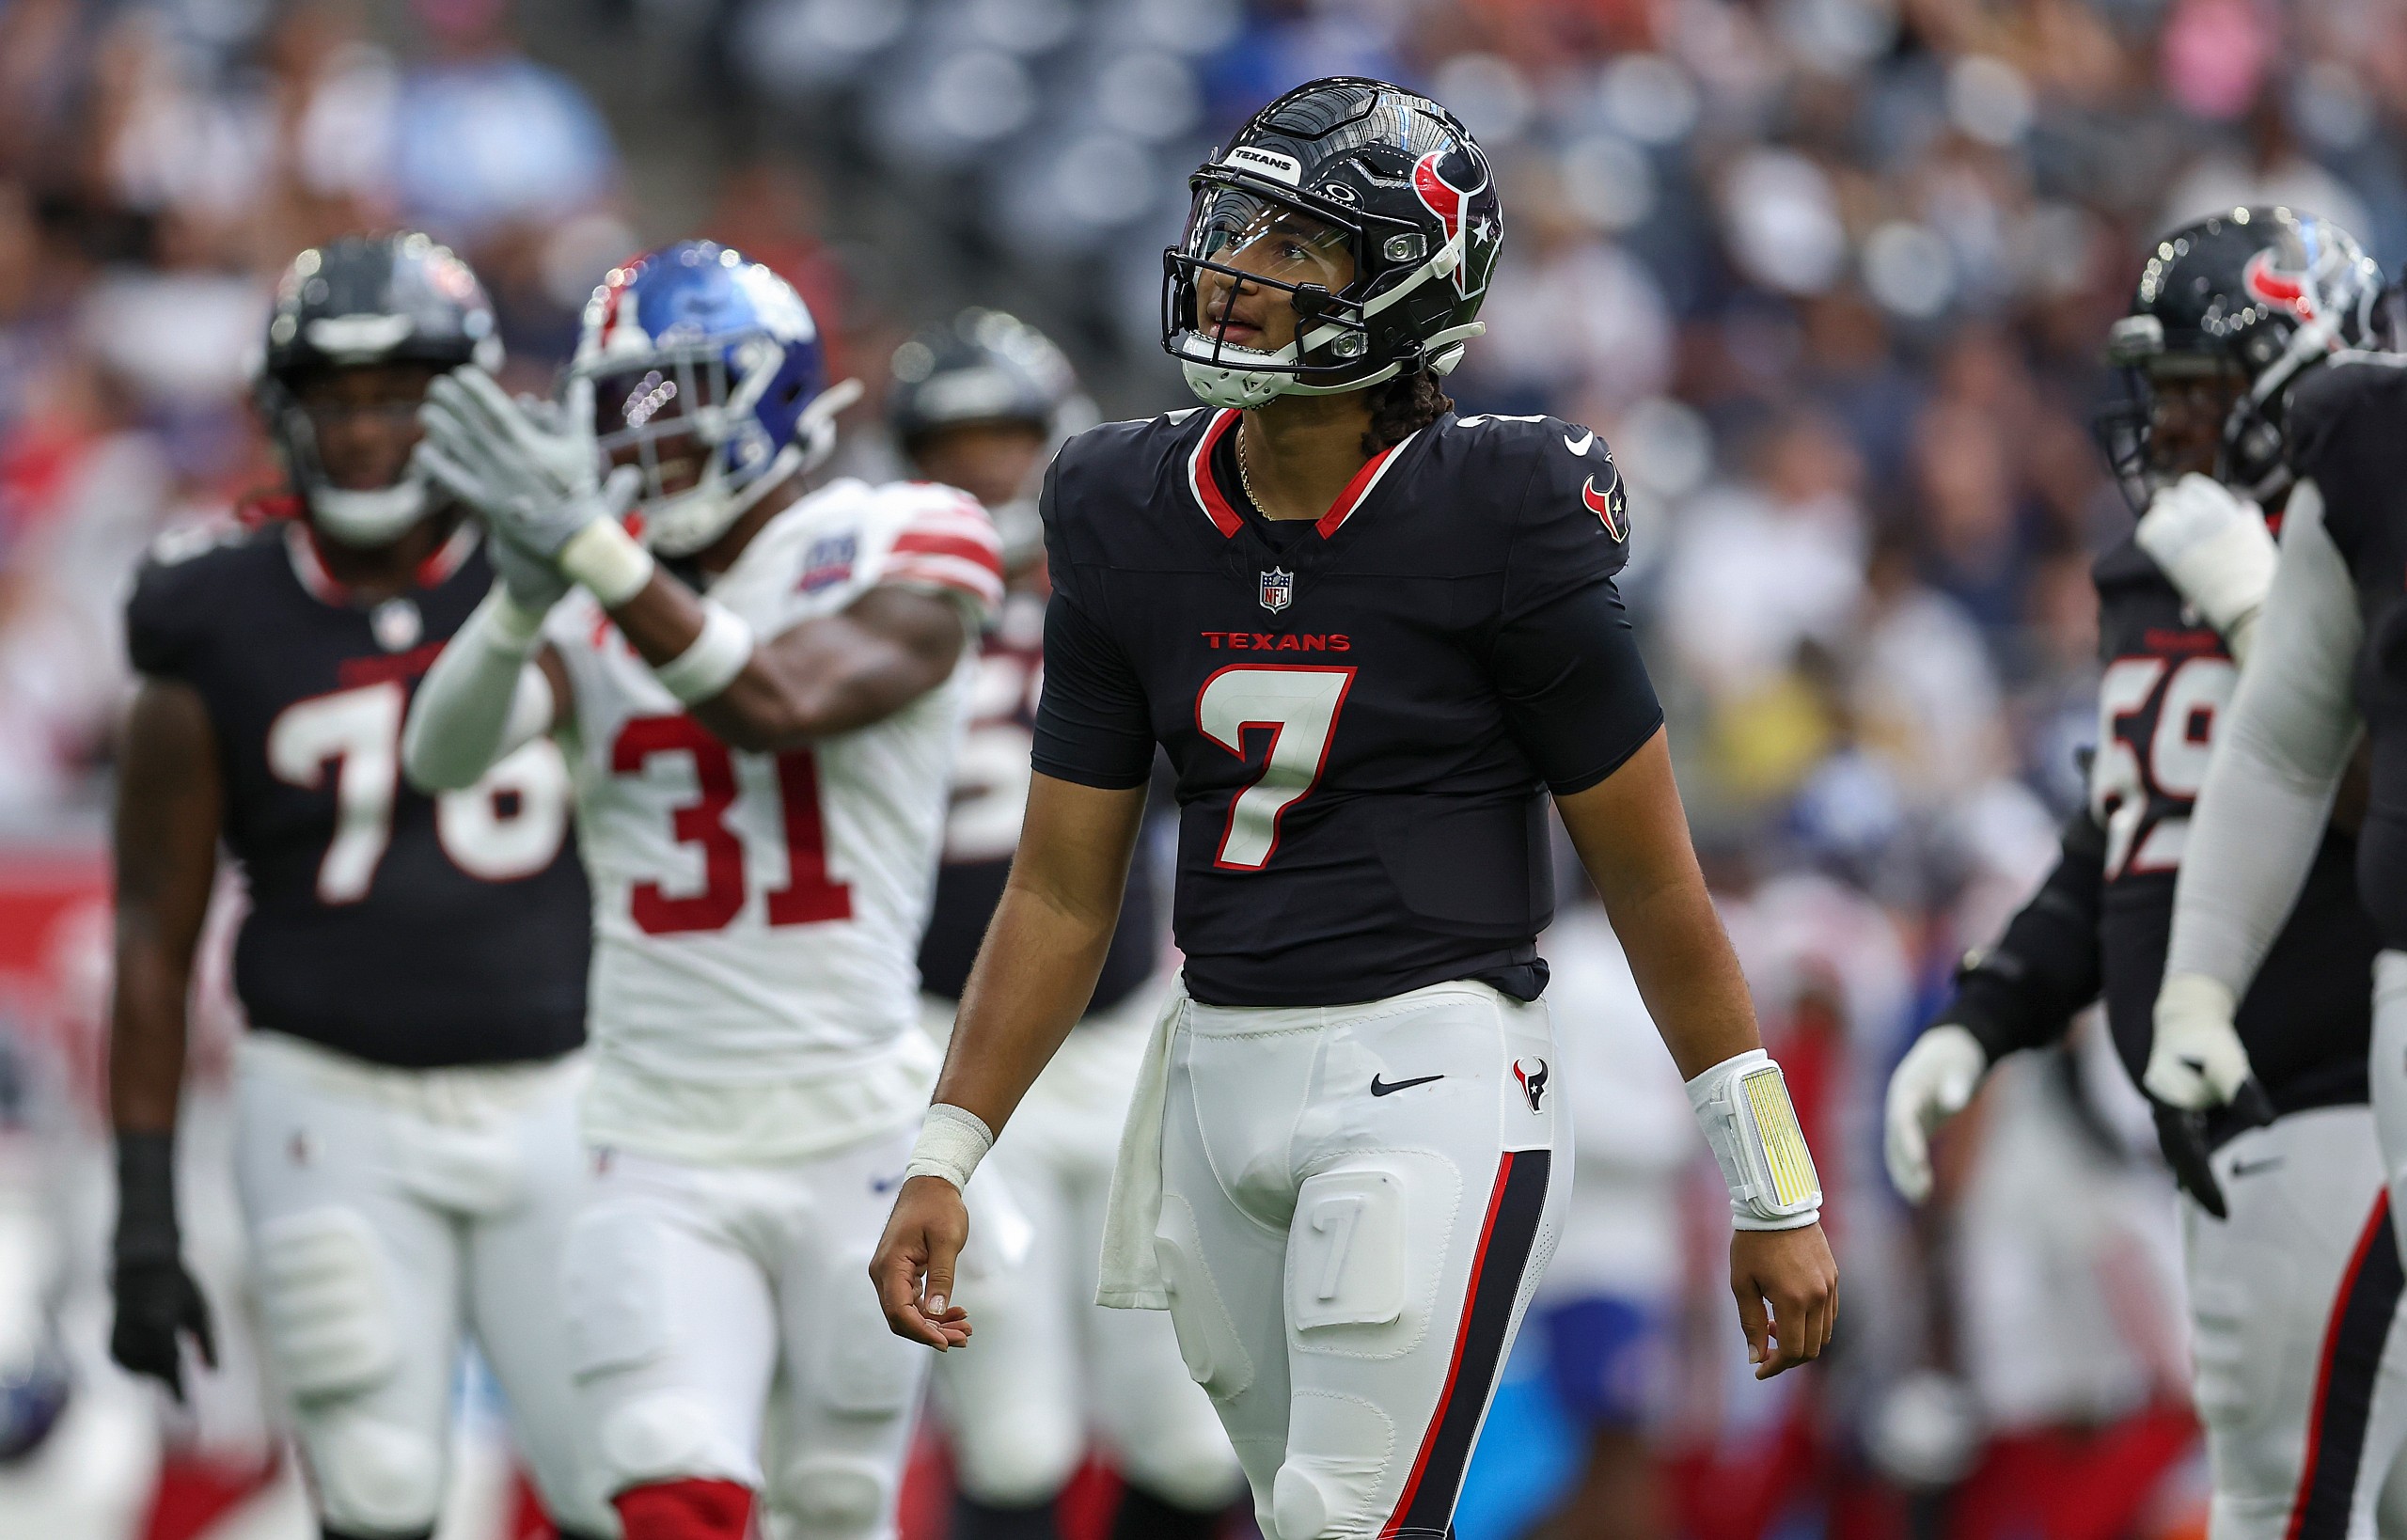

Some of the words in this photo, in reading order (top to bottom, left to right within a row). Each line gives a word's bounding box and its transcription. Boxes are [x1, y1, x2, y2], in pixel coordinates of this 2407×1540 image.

[1235, 149, 1292, 171] TEXANS
[1265, 588, 1287, 605] NFL
[1201, 631, 1351, 652] TEXANS
[1194, 663, 1359, 871] 7
[612, 713, 854, 936] 31
[1313, 1195, 1363, 1300] 7
